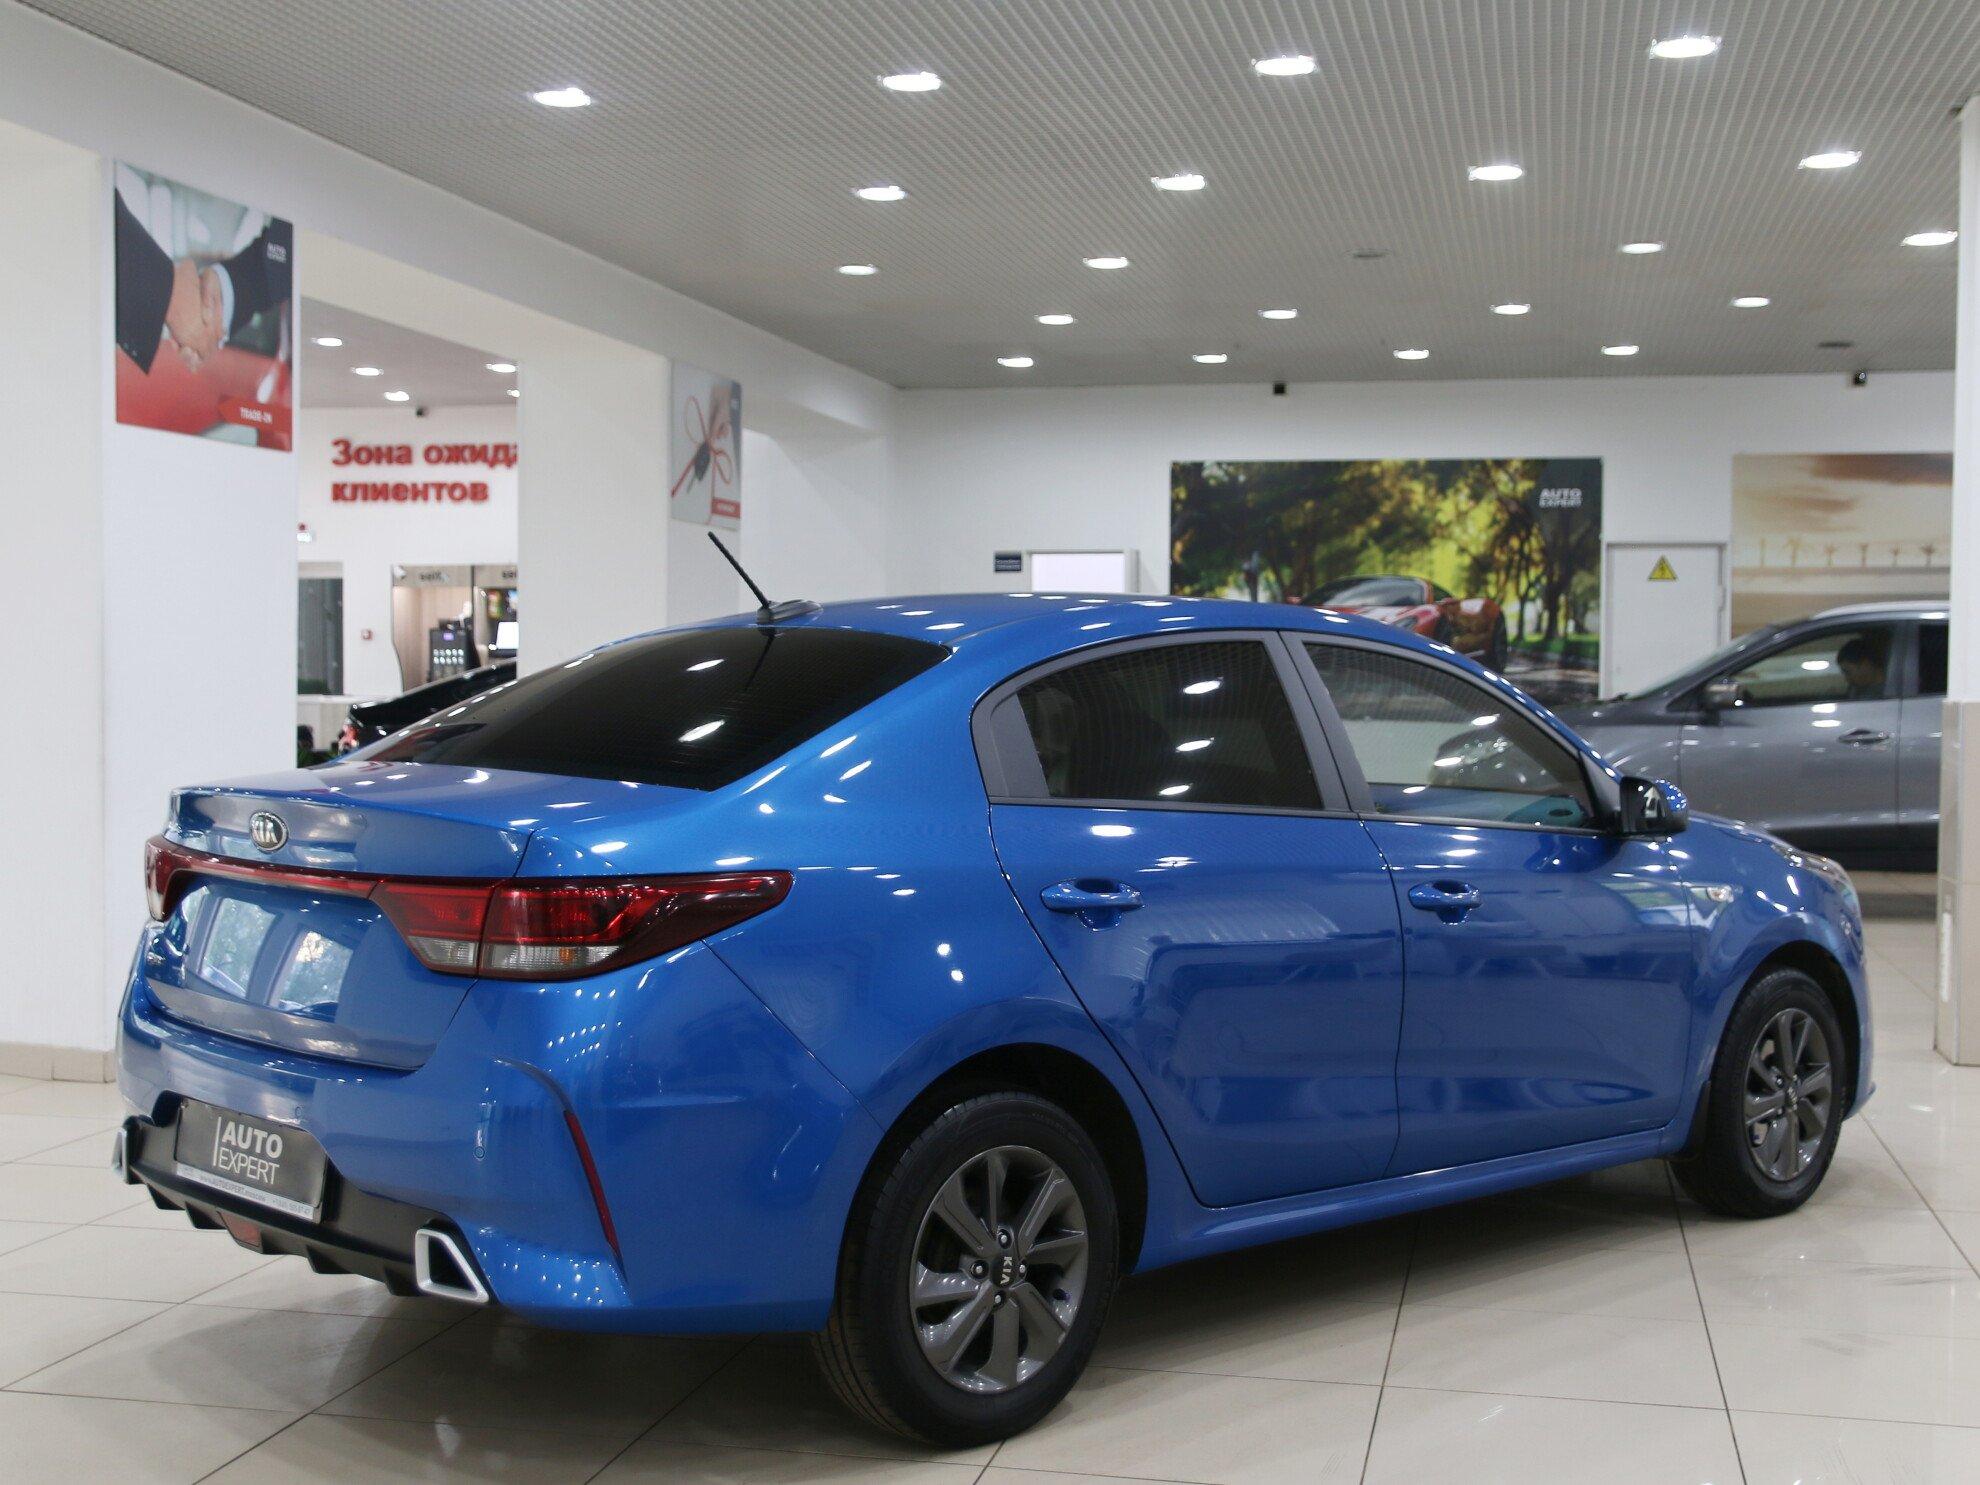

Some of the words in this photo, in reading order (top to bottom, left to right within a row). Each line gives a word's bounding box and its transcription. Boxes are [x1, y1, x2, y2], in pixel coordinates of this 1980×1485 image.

[332, 437, 413, 466] Зона
[332, 482, 489, 502] клиентов
[1540, 488, 1582, 499] AUTO
[221, 1120, 284, 1160] AUTO
[218, 1147, 280, 1186] EXPERT
[1000, 1256, 1013, 1285] KIA
